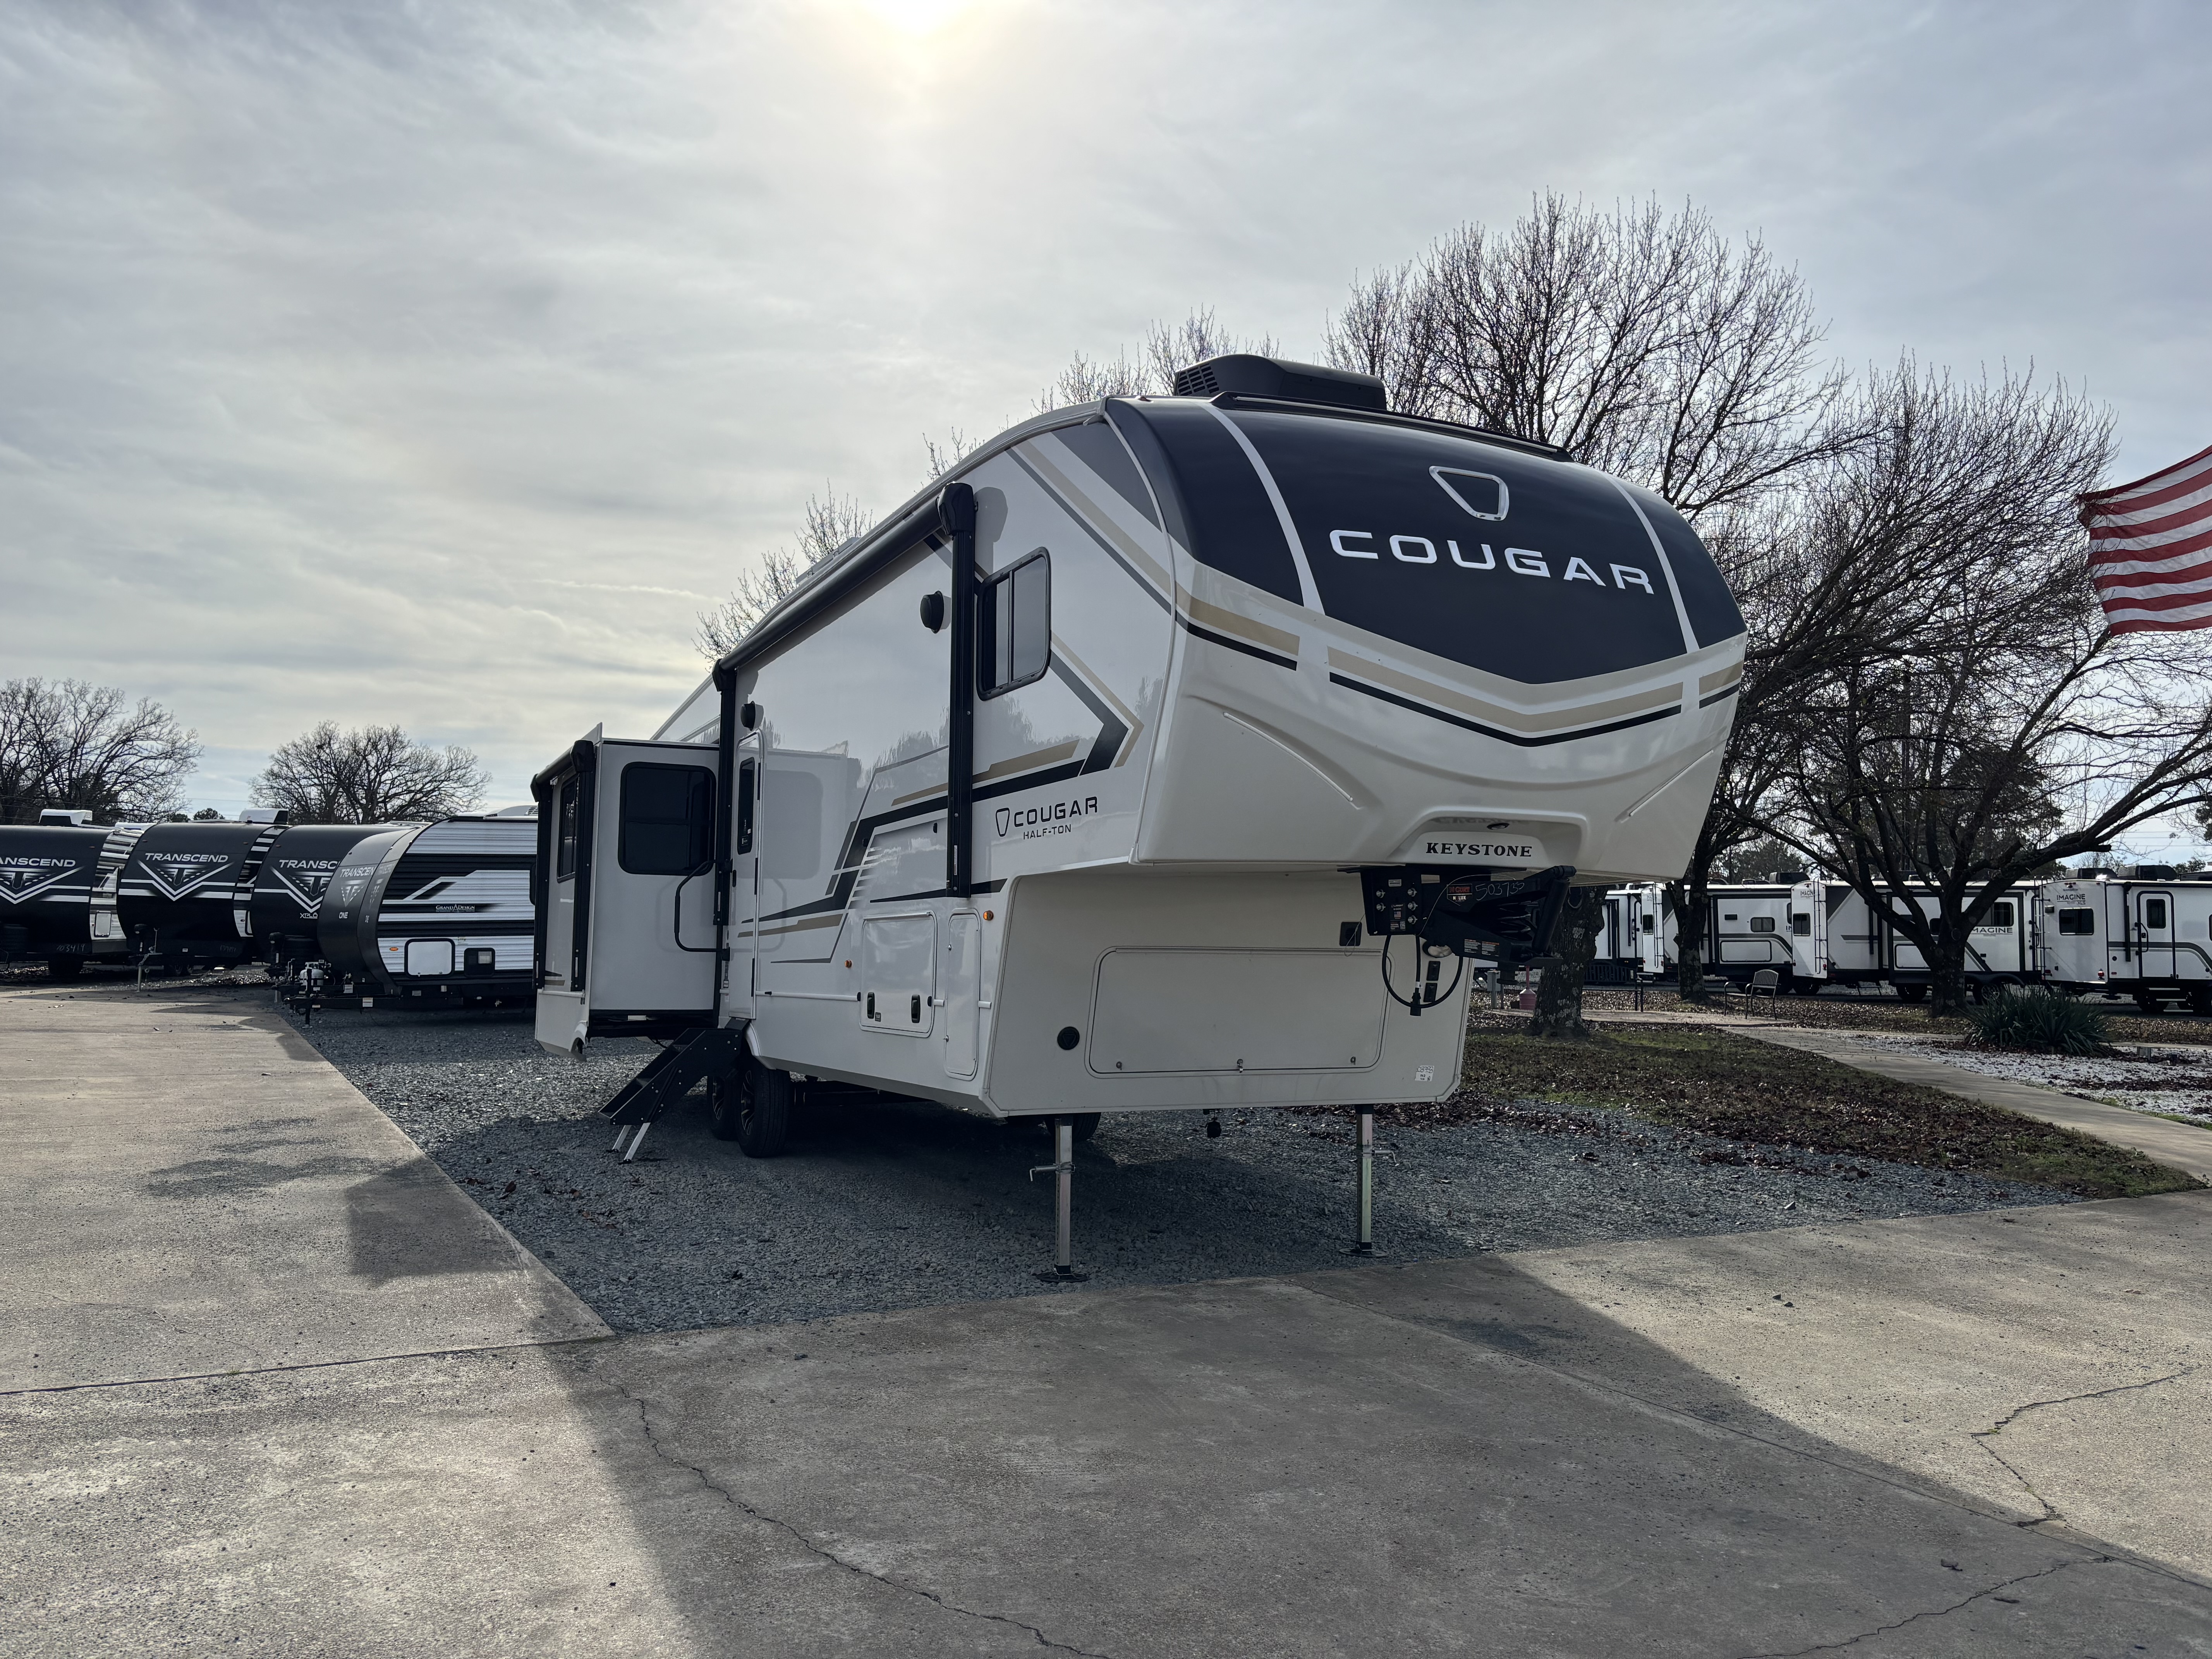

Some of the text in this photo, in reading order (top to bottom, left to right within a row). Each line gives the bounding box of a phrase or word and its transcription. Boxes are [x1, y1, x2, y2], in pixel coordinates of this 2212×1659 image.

[1329, 529, 1654, 594] COUGAR
[1014, 796, 1098, 828] COUGAR
[1023, 824, 1072, 840] HALF-TON
[1425, 842, 1532, 857] KEYSTONE
[145, 853, 228, 863] TRANSCEND
[279, 859, 340, 869] TRANSC
